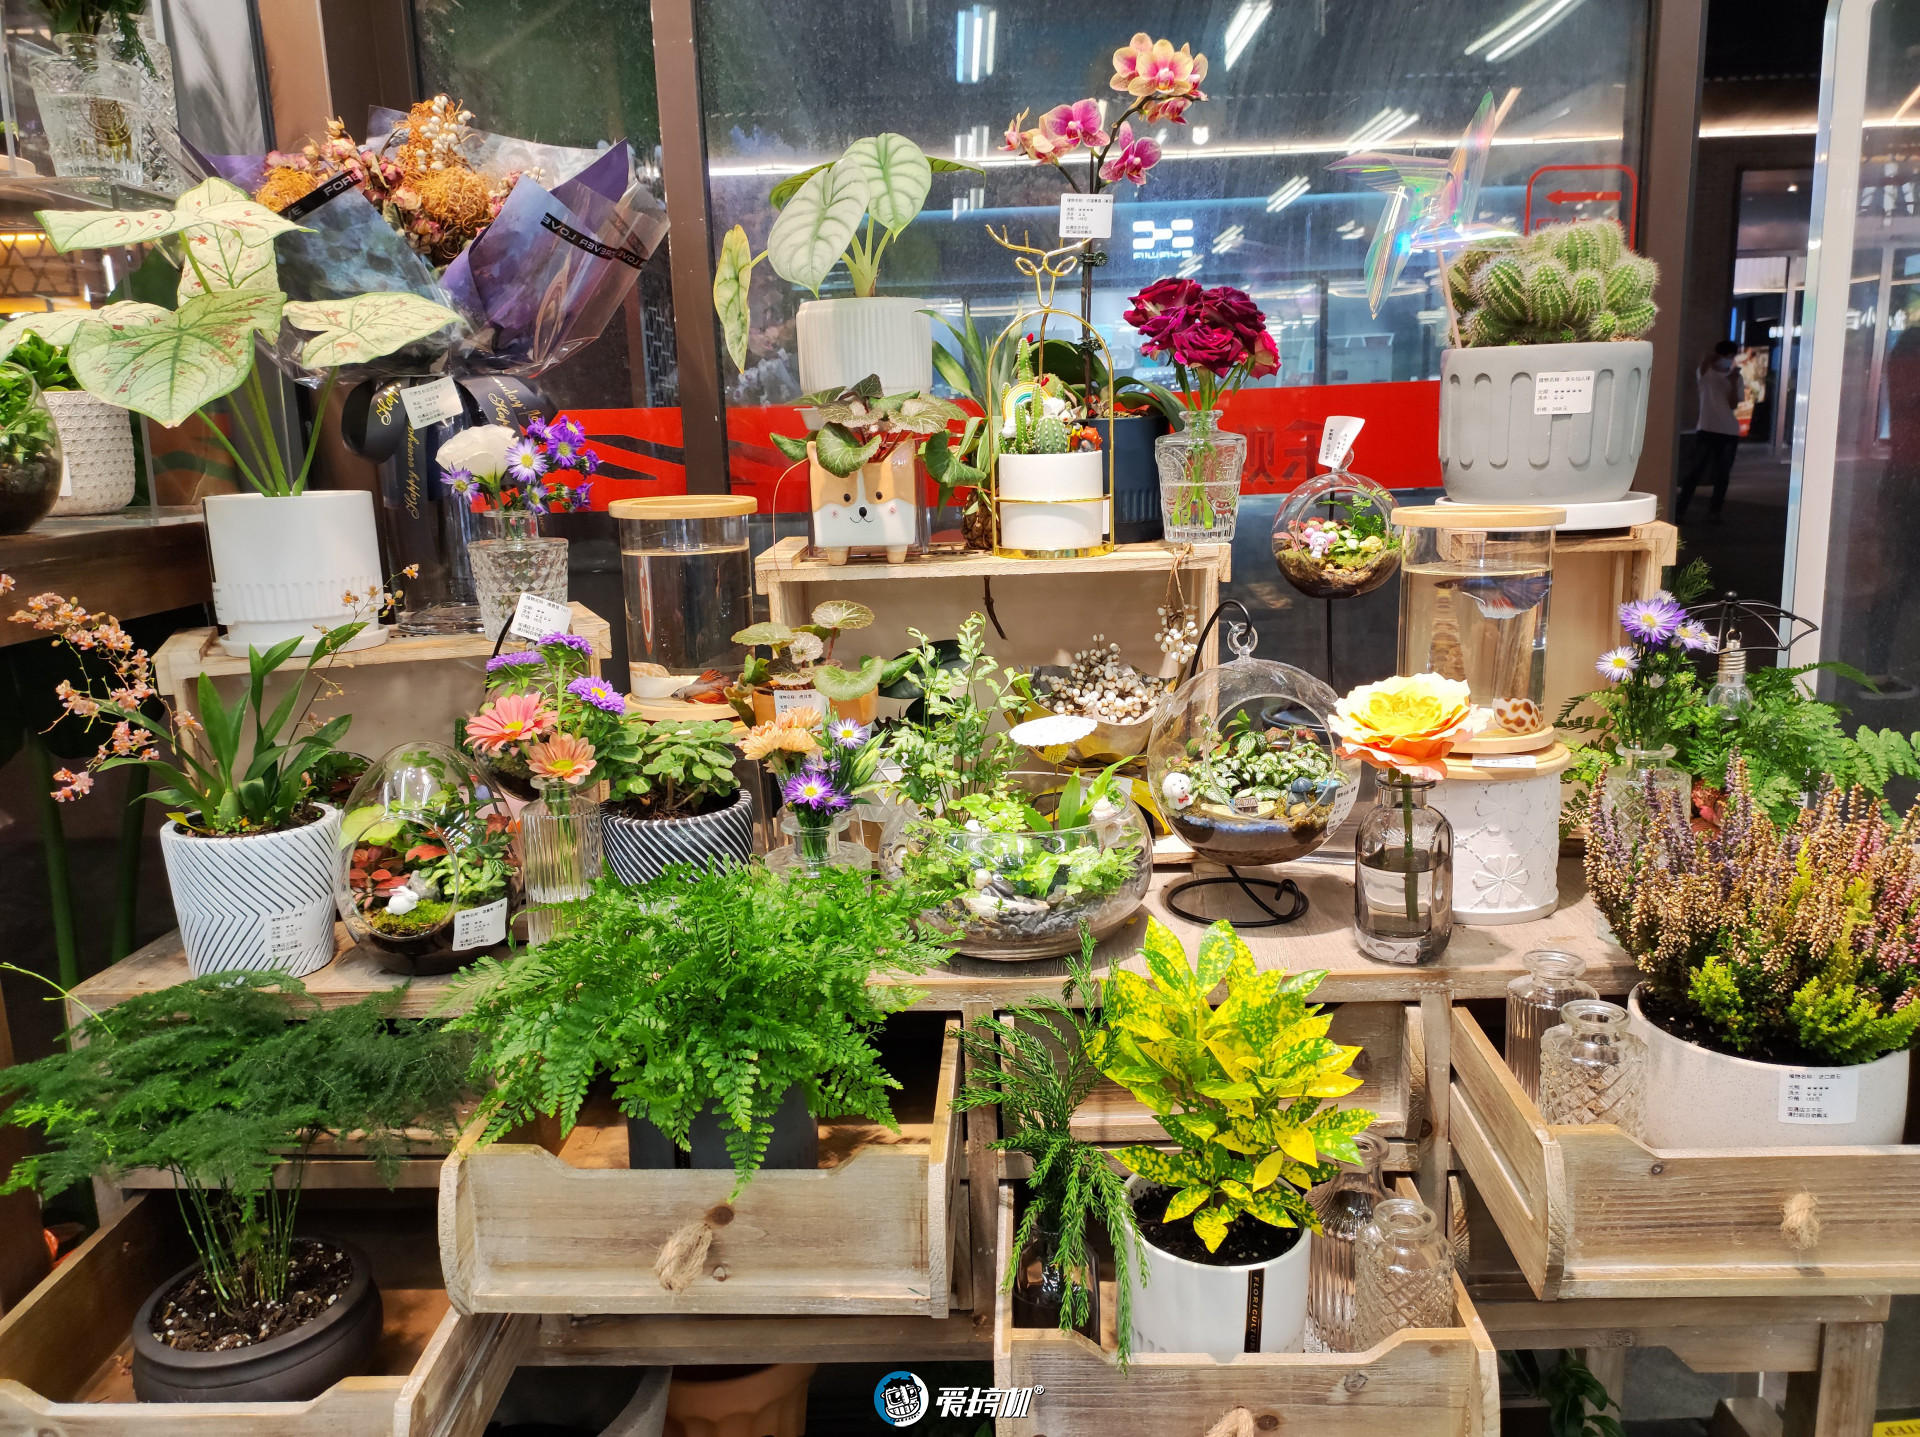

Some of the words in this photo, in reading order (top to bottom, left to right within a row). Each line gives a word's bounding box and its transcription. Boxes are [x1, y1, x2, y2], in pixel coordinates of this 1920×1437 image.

[407, 421, 421, 468] everyda
[404, 470, 421, 520] Happy
[1249, 1276, 1260, 1351] FLORICULTUR
